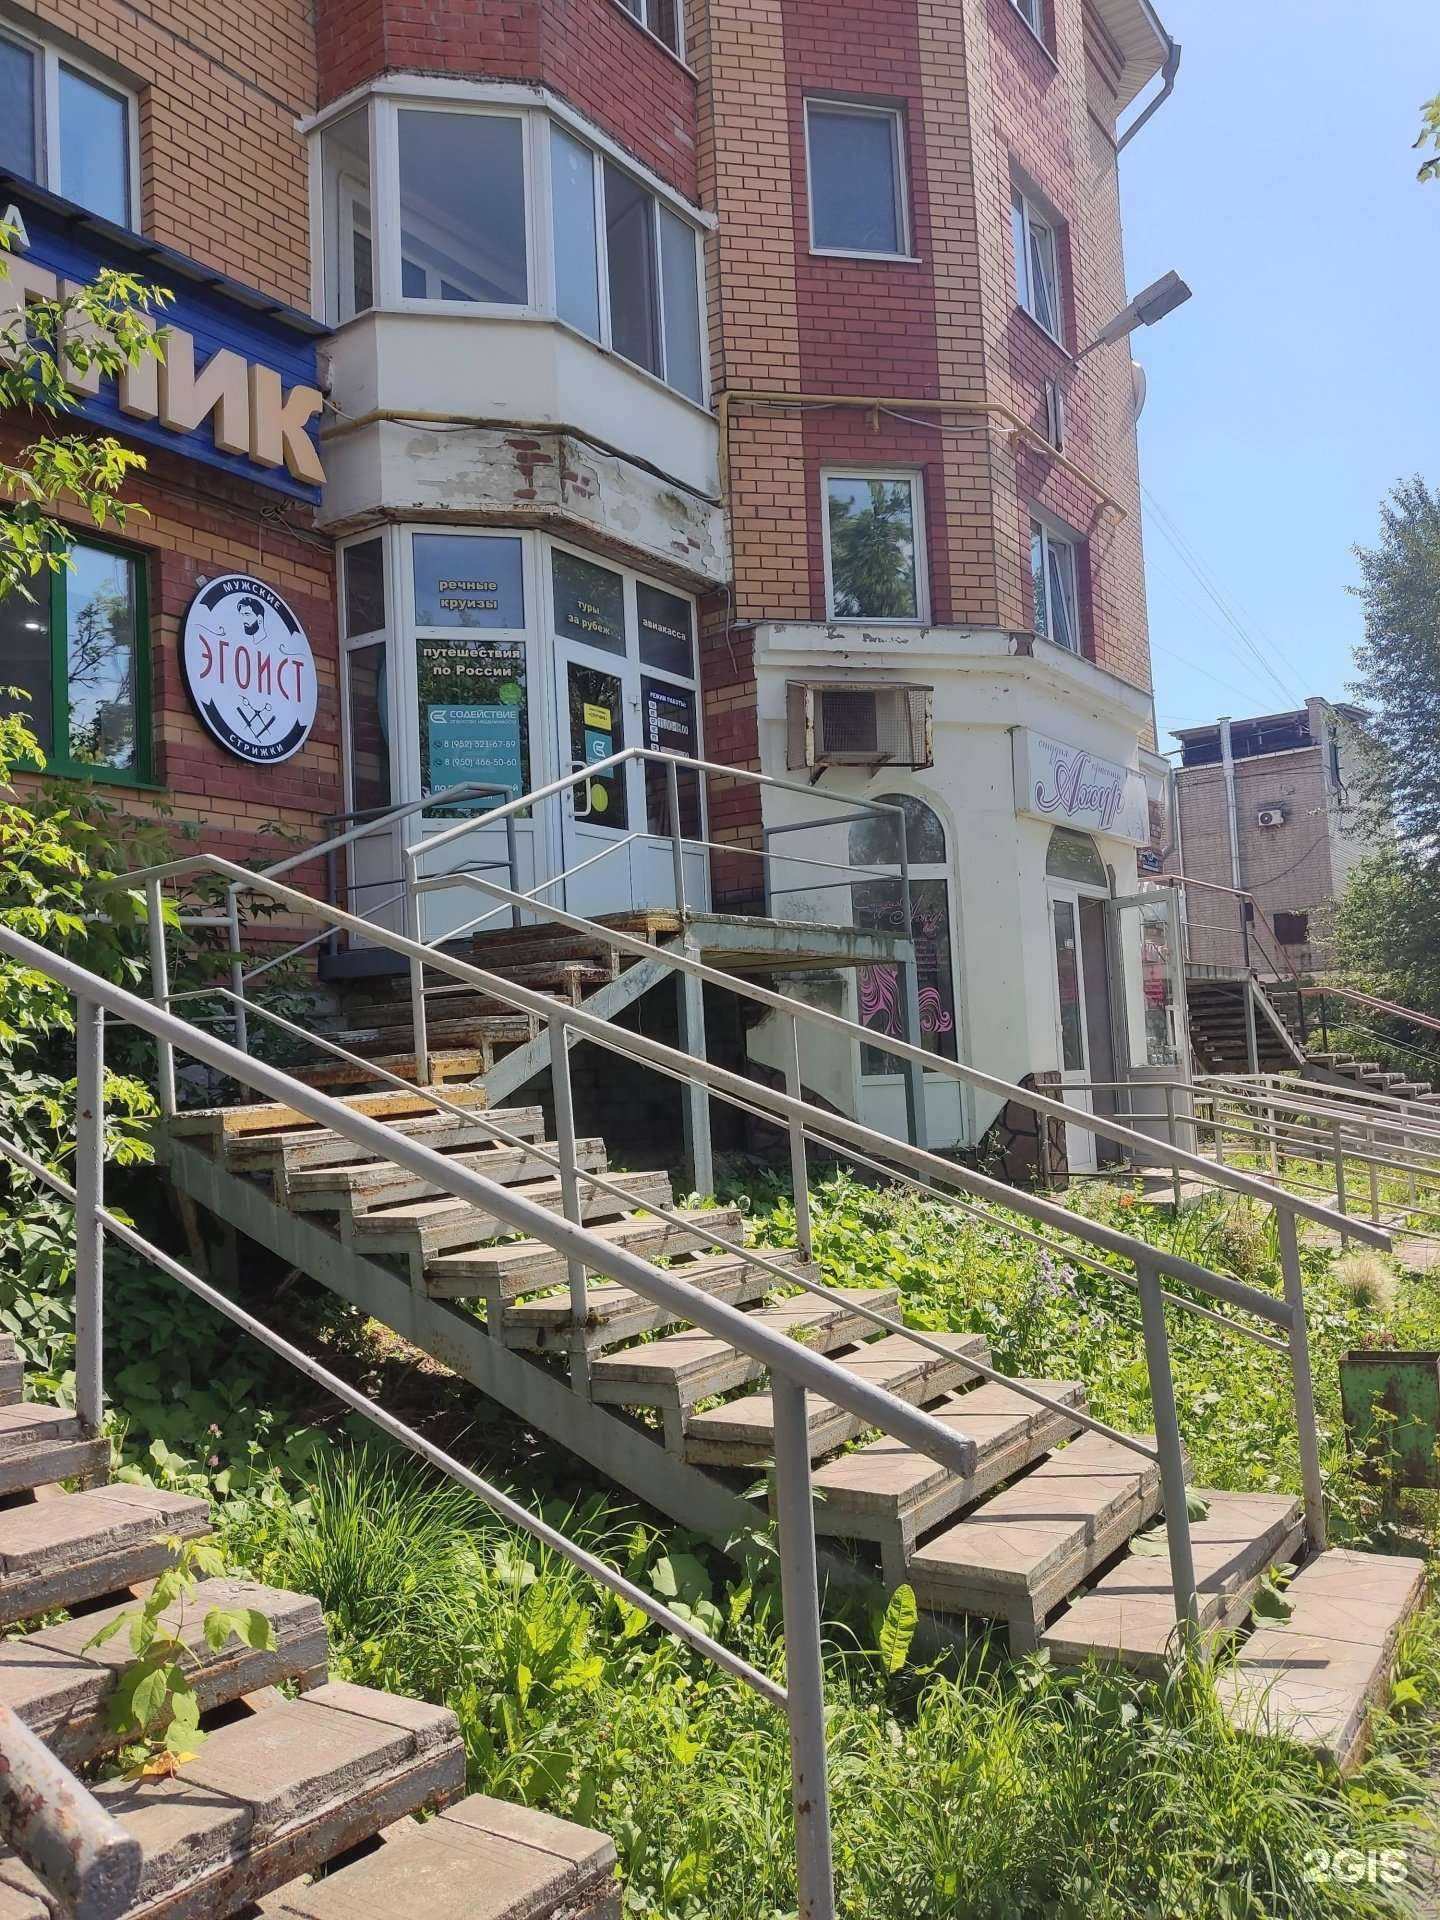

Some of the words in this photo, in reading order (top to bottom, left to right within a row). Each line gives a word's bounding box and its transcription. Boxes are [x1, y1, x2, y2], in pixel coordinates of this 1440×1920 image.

[439, 580, 497, 592] речные
[223, 579, 281, 610] МУЖСКИЕ
[440, 599, 498, 610] круизы
[577, 600, 600, 615] туры
[568, 614, 579, 624] за
[642, 617, 686, 641] авиакасса
[423, 647, 520, 659] путешествия
[199, 634, 304, 702] ЭГОИСТ
[433, 666, 451, 676] по
[456, 665, 512, 677] России
[449, 709, 517, 720] СОДЕЙСТВИЕ
[229, 733, 284, 757] СТРИЖКИ
